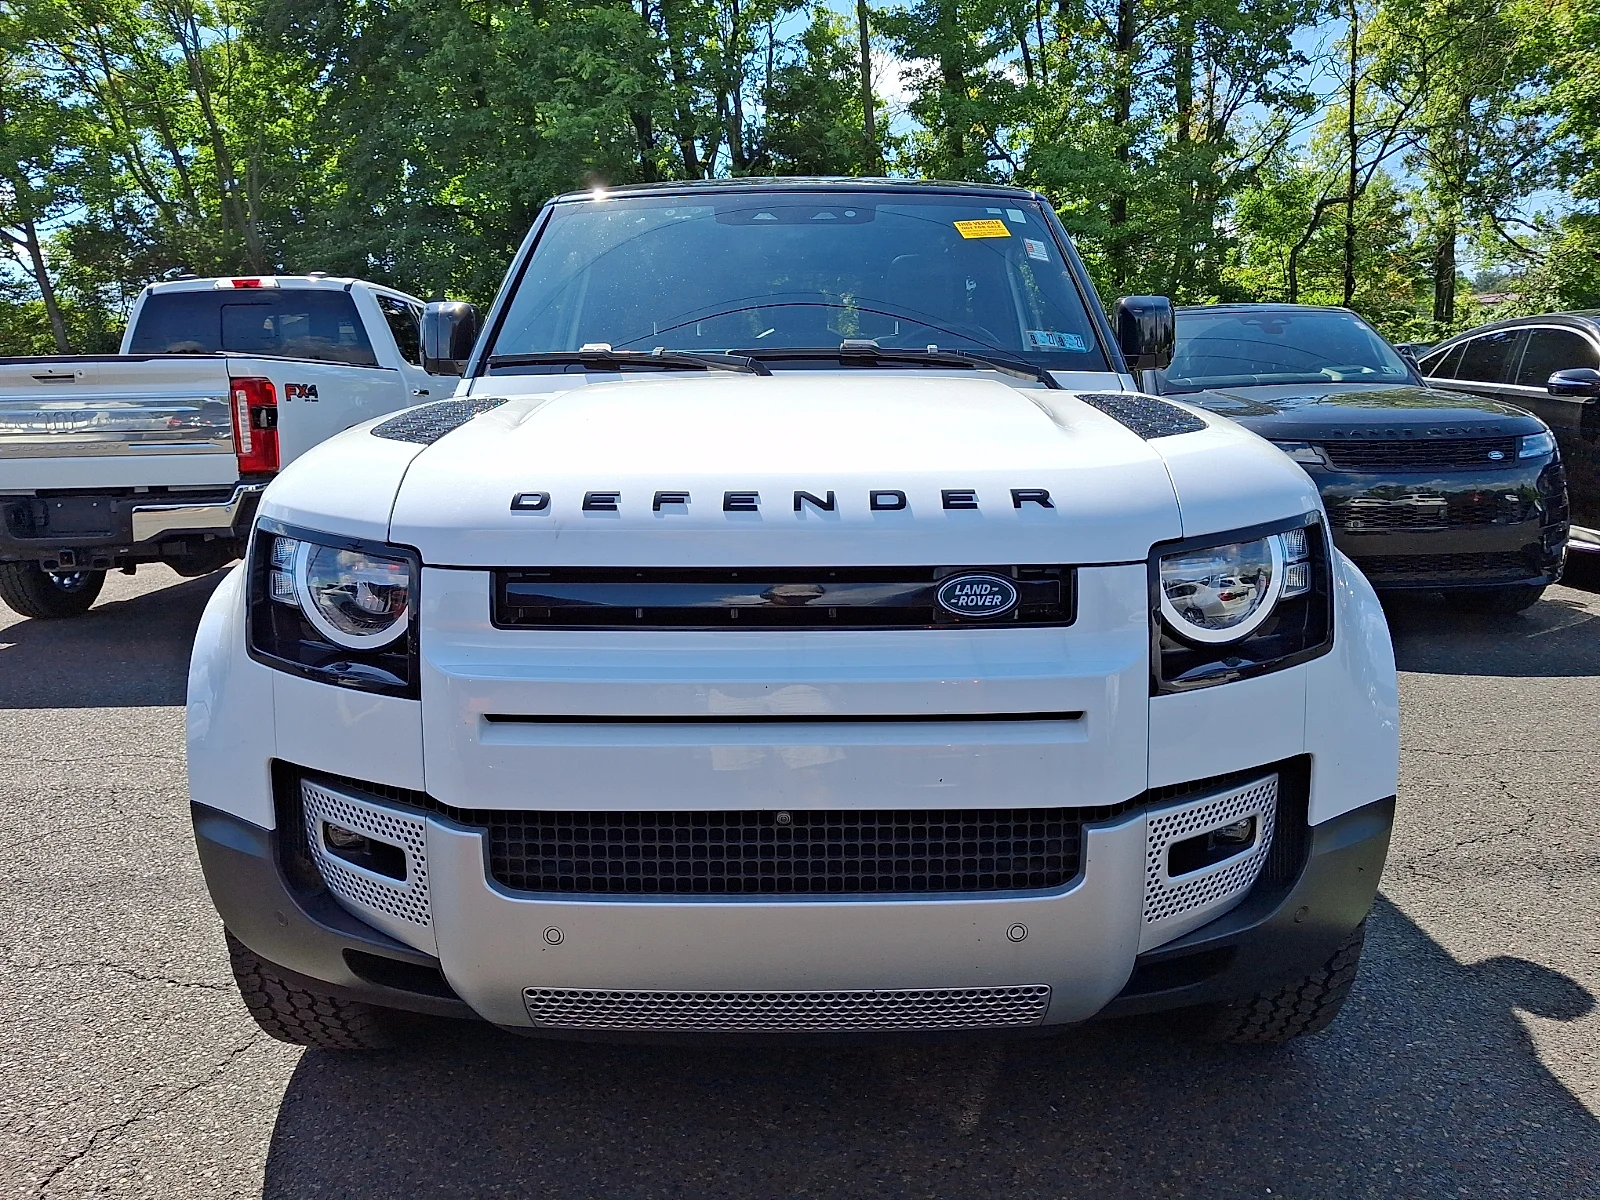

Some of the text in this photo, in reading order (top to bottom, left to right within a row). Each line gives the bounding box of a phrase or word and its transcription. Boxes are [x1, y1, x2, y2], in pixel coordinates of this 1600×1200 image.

[284, 383, 318, 402] FX4
[1332, 425, 1501, 436] RANGE ROVER
[510, 488, 1055, 512] DEFENDER
